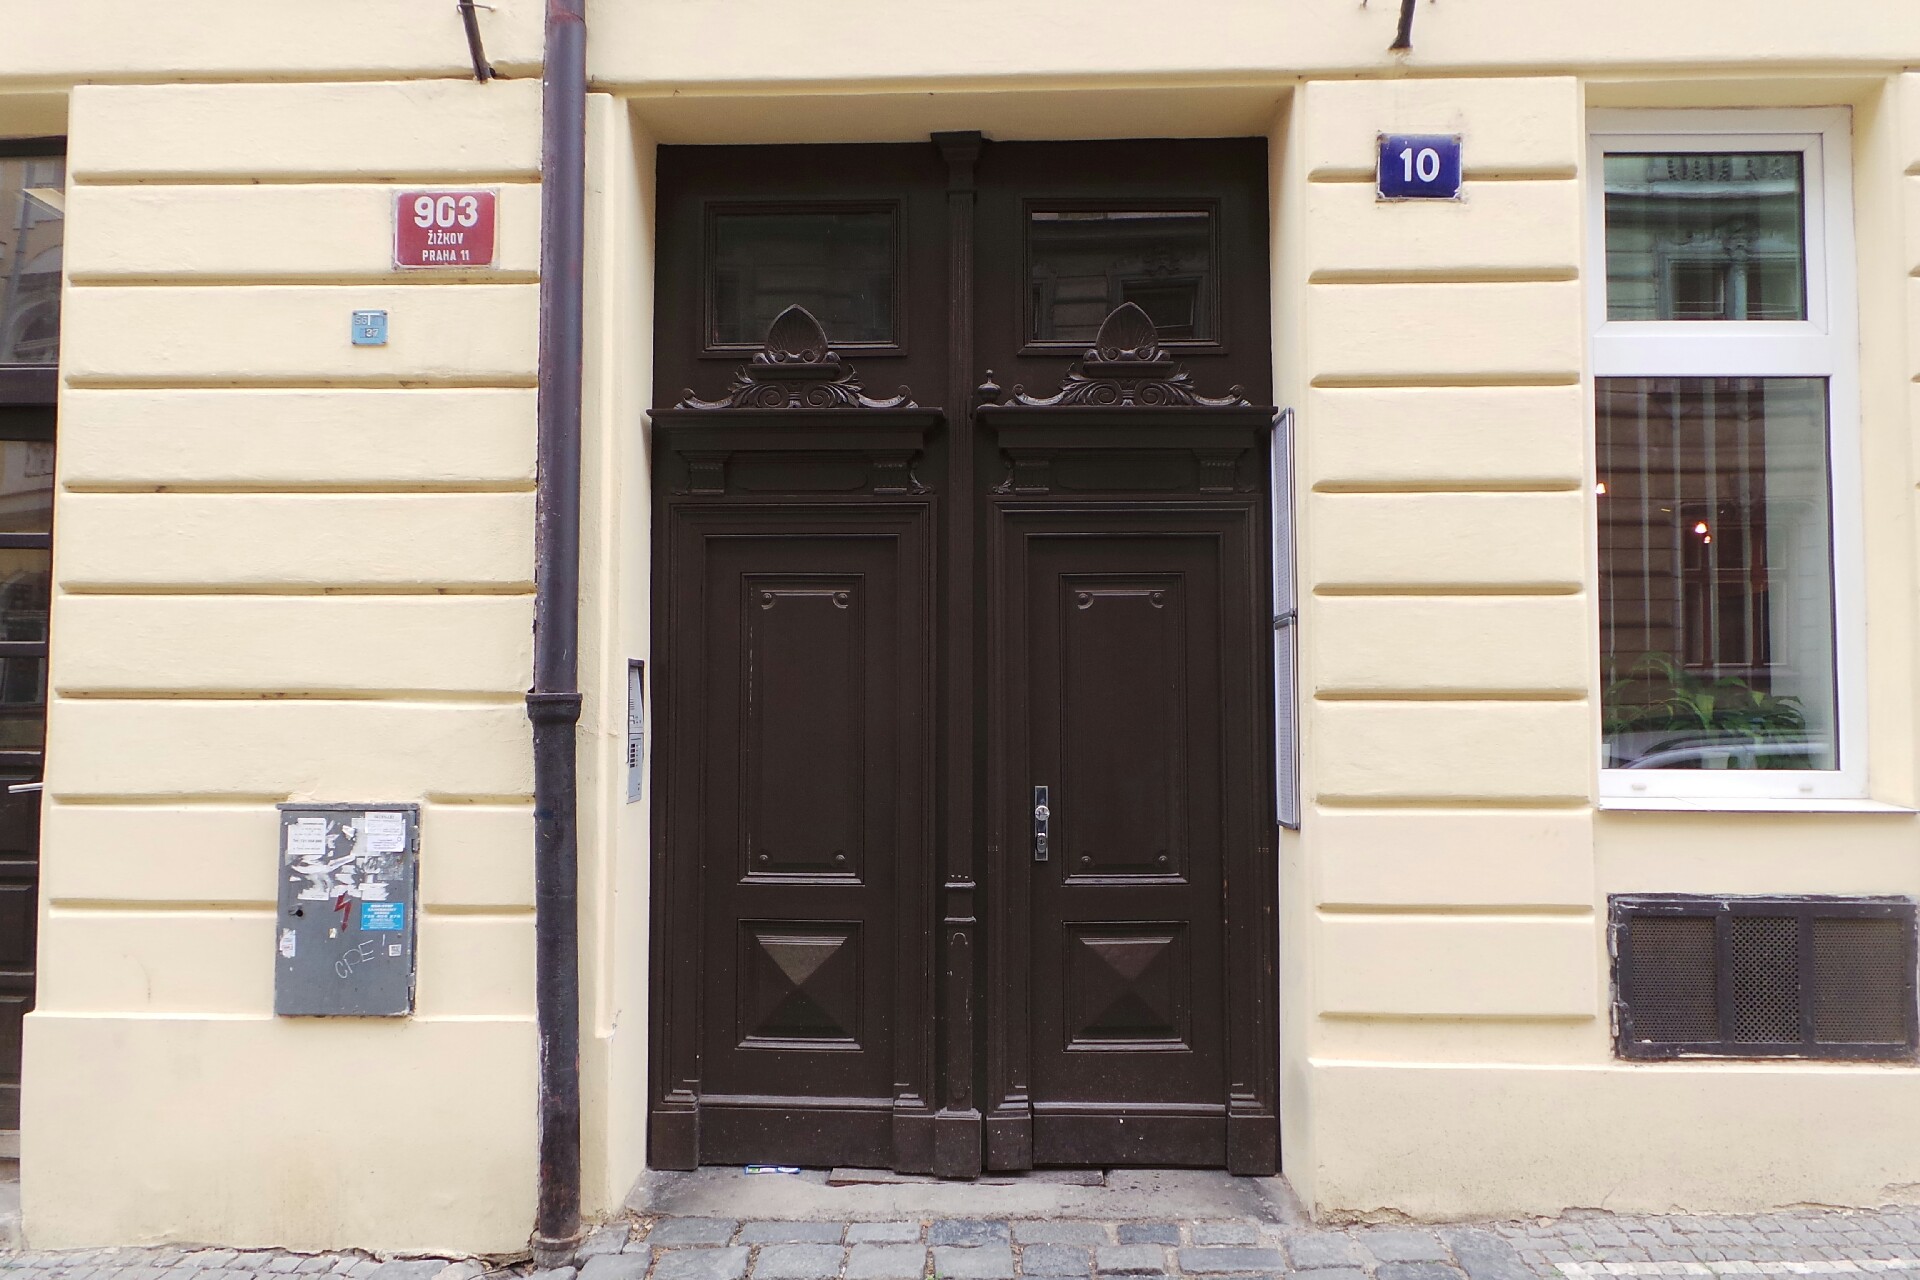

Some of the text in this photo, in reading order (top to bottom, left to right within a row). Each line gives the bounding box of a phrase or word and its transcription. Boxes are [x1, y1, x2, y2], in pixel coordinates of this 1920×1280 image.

[1399, 147, 1440, 182] 10
[414, 195, 479, 228] 903
[427, 229, 464, 245] ŽIŽKOV
[422, 250, 470, 261] PRAHA 11
